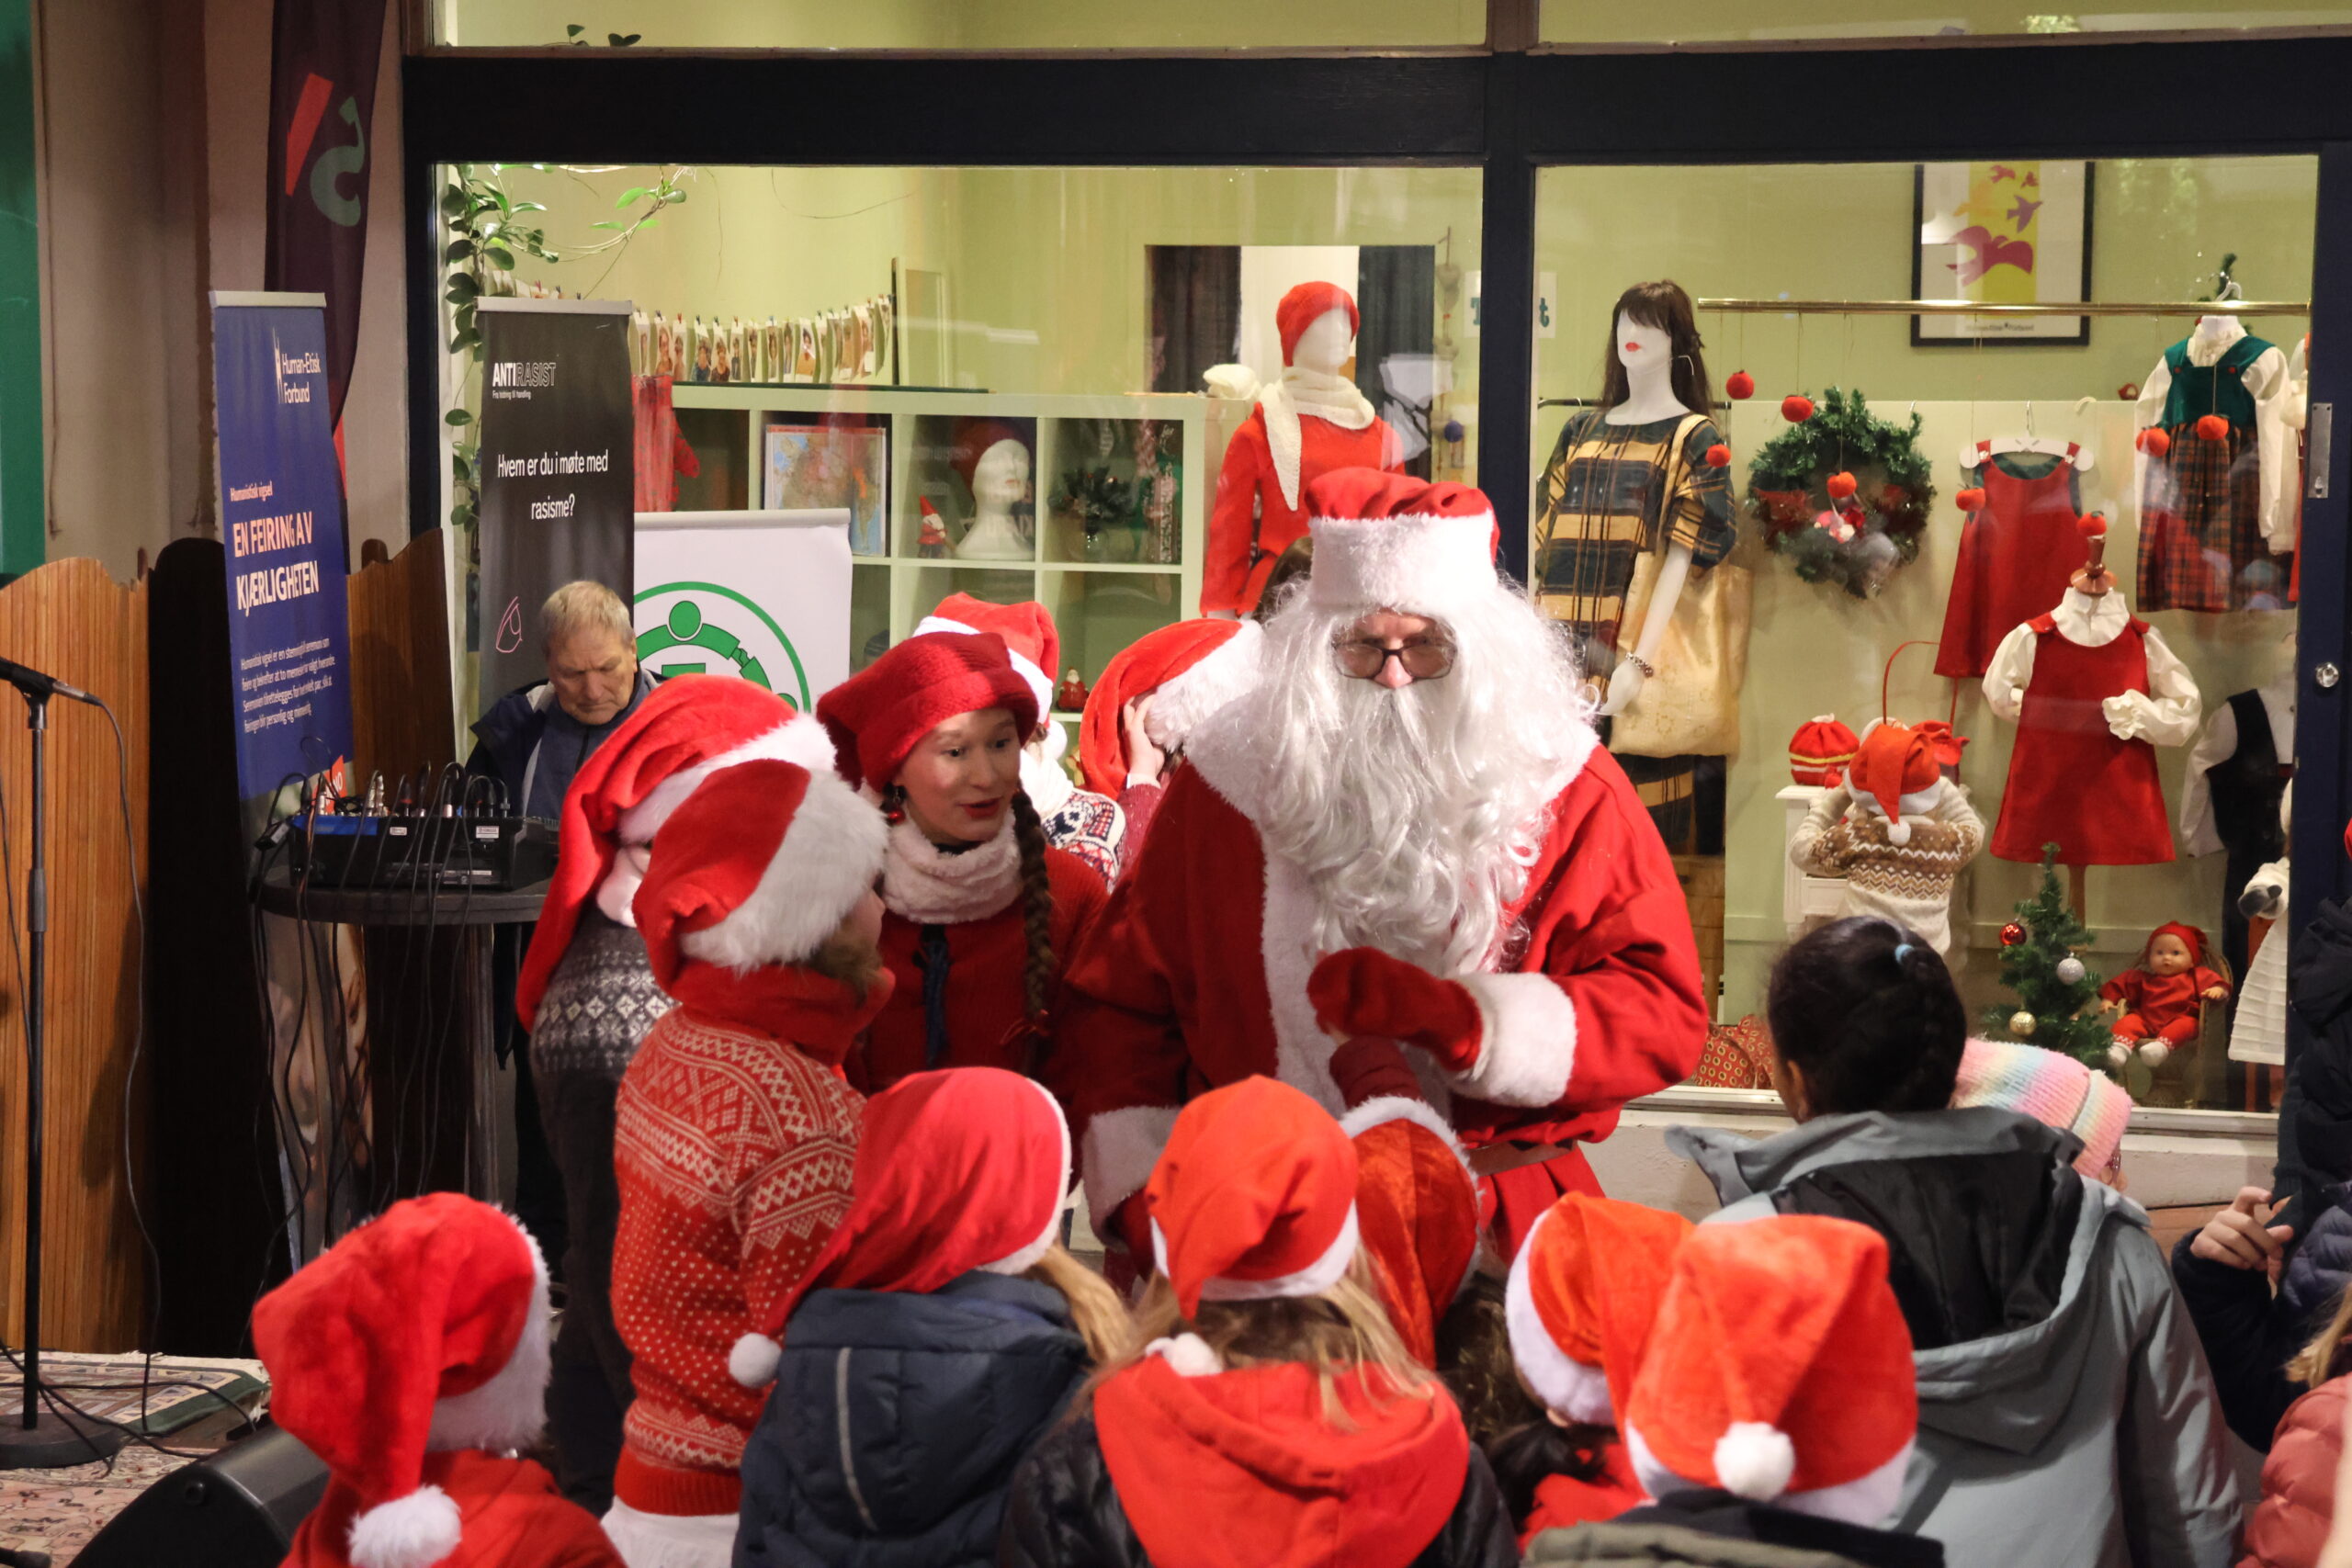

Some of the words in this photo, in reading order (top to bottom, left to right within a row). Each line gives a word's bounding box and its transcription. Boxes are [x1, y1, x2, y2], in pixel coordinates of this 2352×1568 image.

[281, 352, 322, 375] Human-Etisk
[284, 381, 311, 404] Forbund
[497, 454, 526, 478] Hvem
[526, 458, 538, 477] er
[540, 451, 553, 476] du
[555, 451, 559, 474] i
[560, 450, 585, 474] møte
[586, 448, 608, 472] med
[531, 493, 576, 520] rasisme?
[232, 521, 250, 558] EN
[250, 513, 296, 555] FEIRING
[296, 511, 313, 547] AV
[236, 559, 320, 618] KJÆRLIGHETEN
